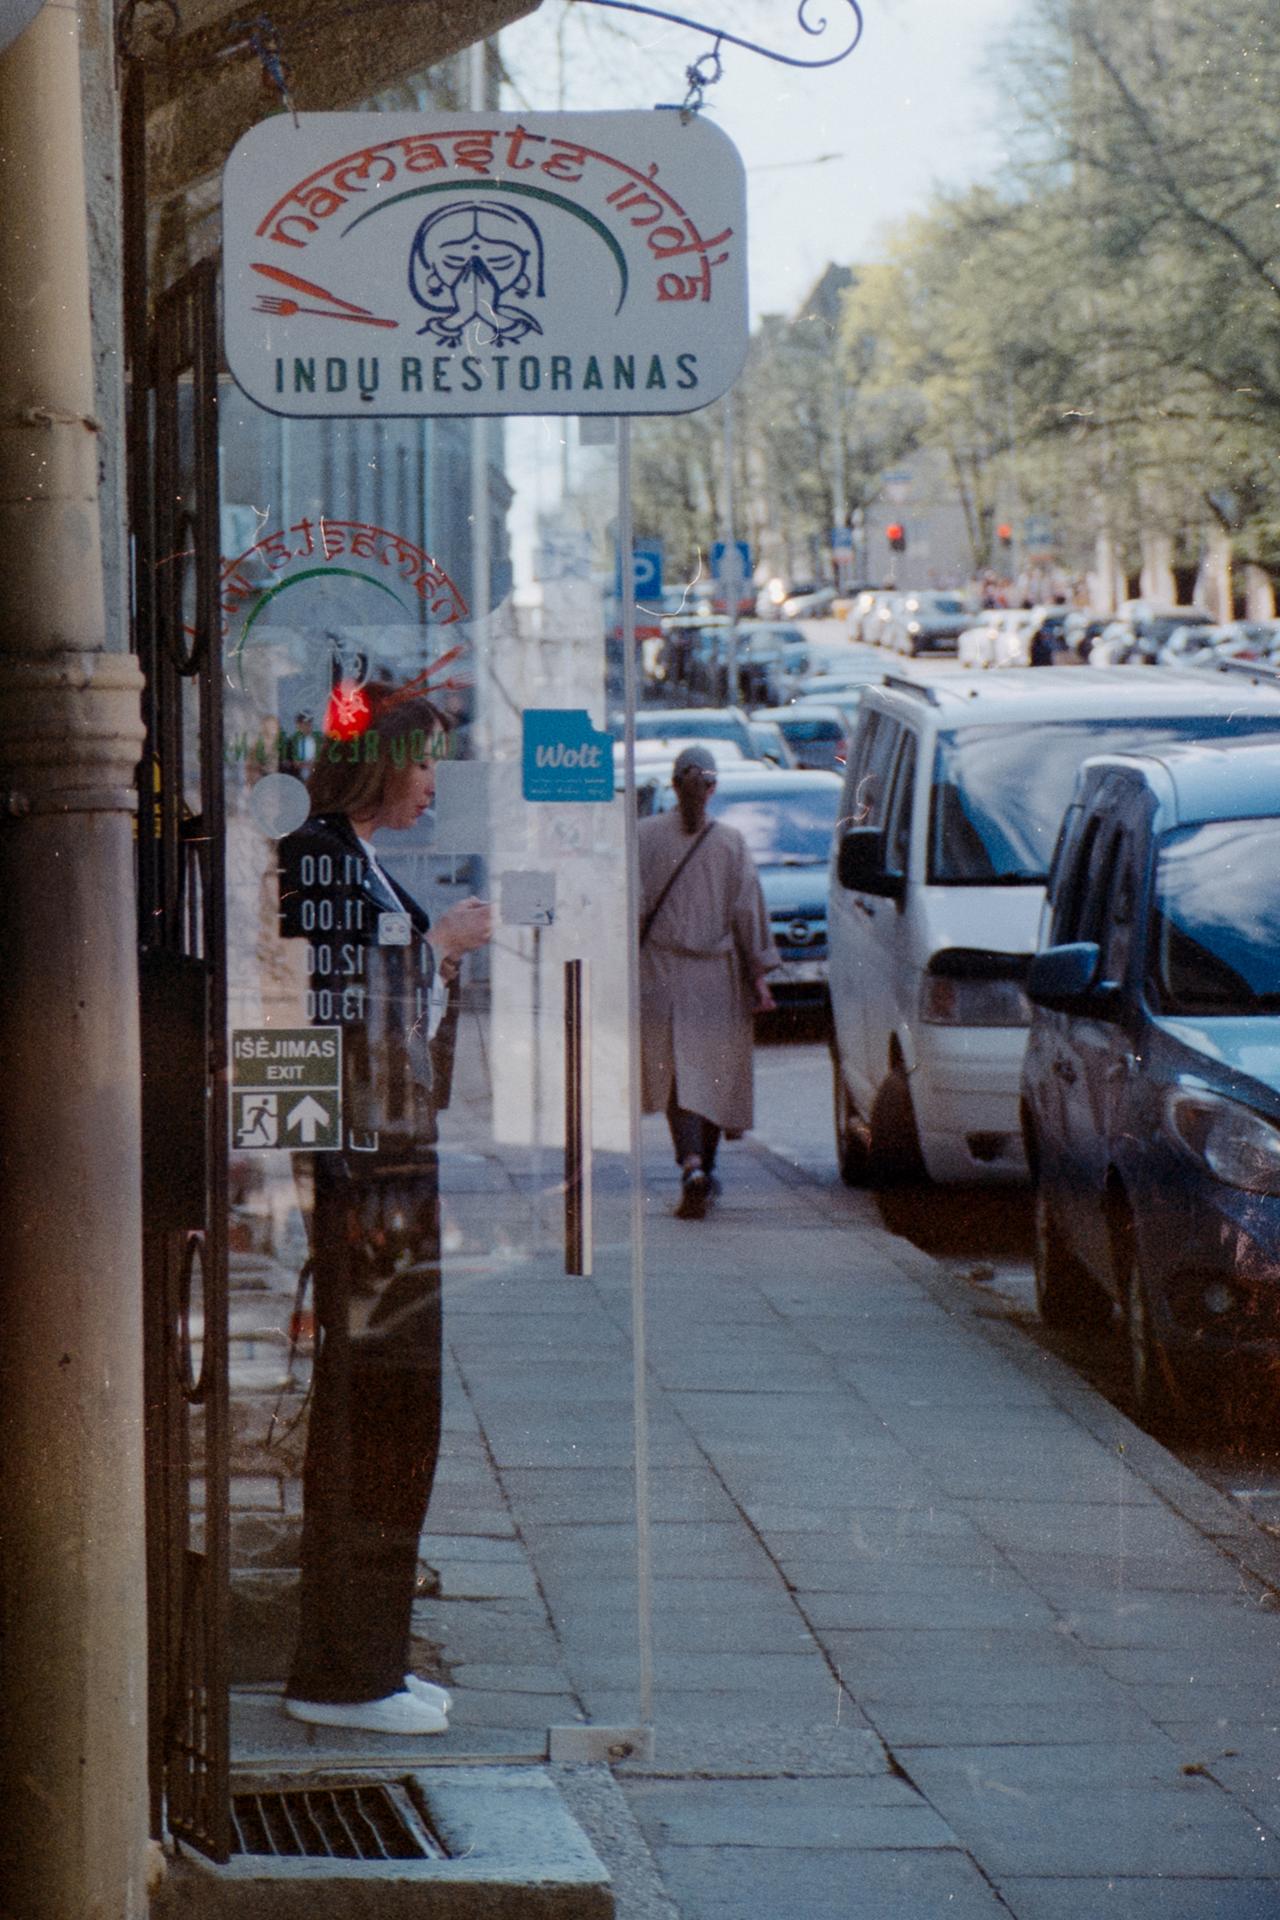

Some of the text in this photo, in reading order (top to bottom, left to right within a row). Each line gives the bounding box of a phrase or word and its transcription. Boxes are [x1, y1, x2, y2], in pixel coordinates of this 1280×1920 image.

[402, 353, 699, 393] RESTORANAS
[534, 741, 603, 770] Wolt
[234, 1036, 336, 1059] IŠĖJIMAS
[266, 1065, 305, 1081] EXIT
